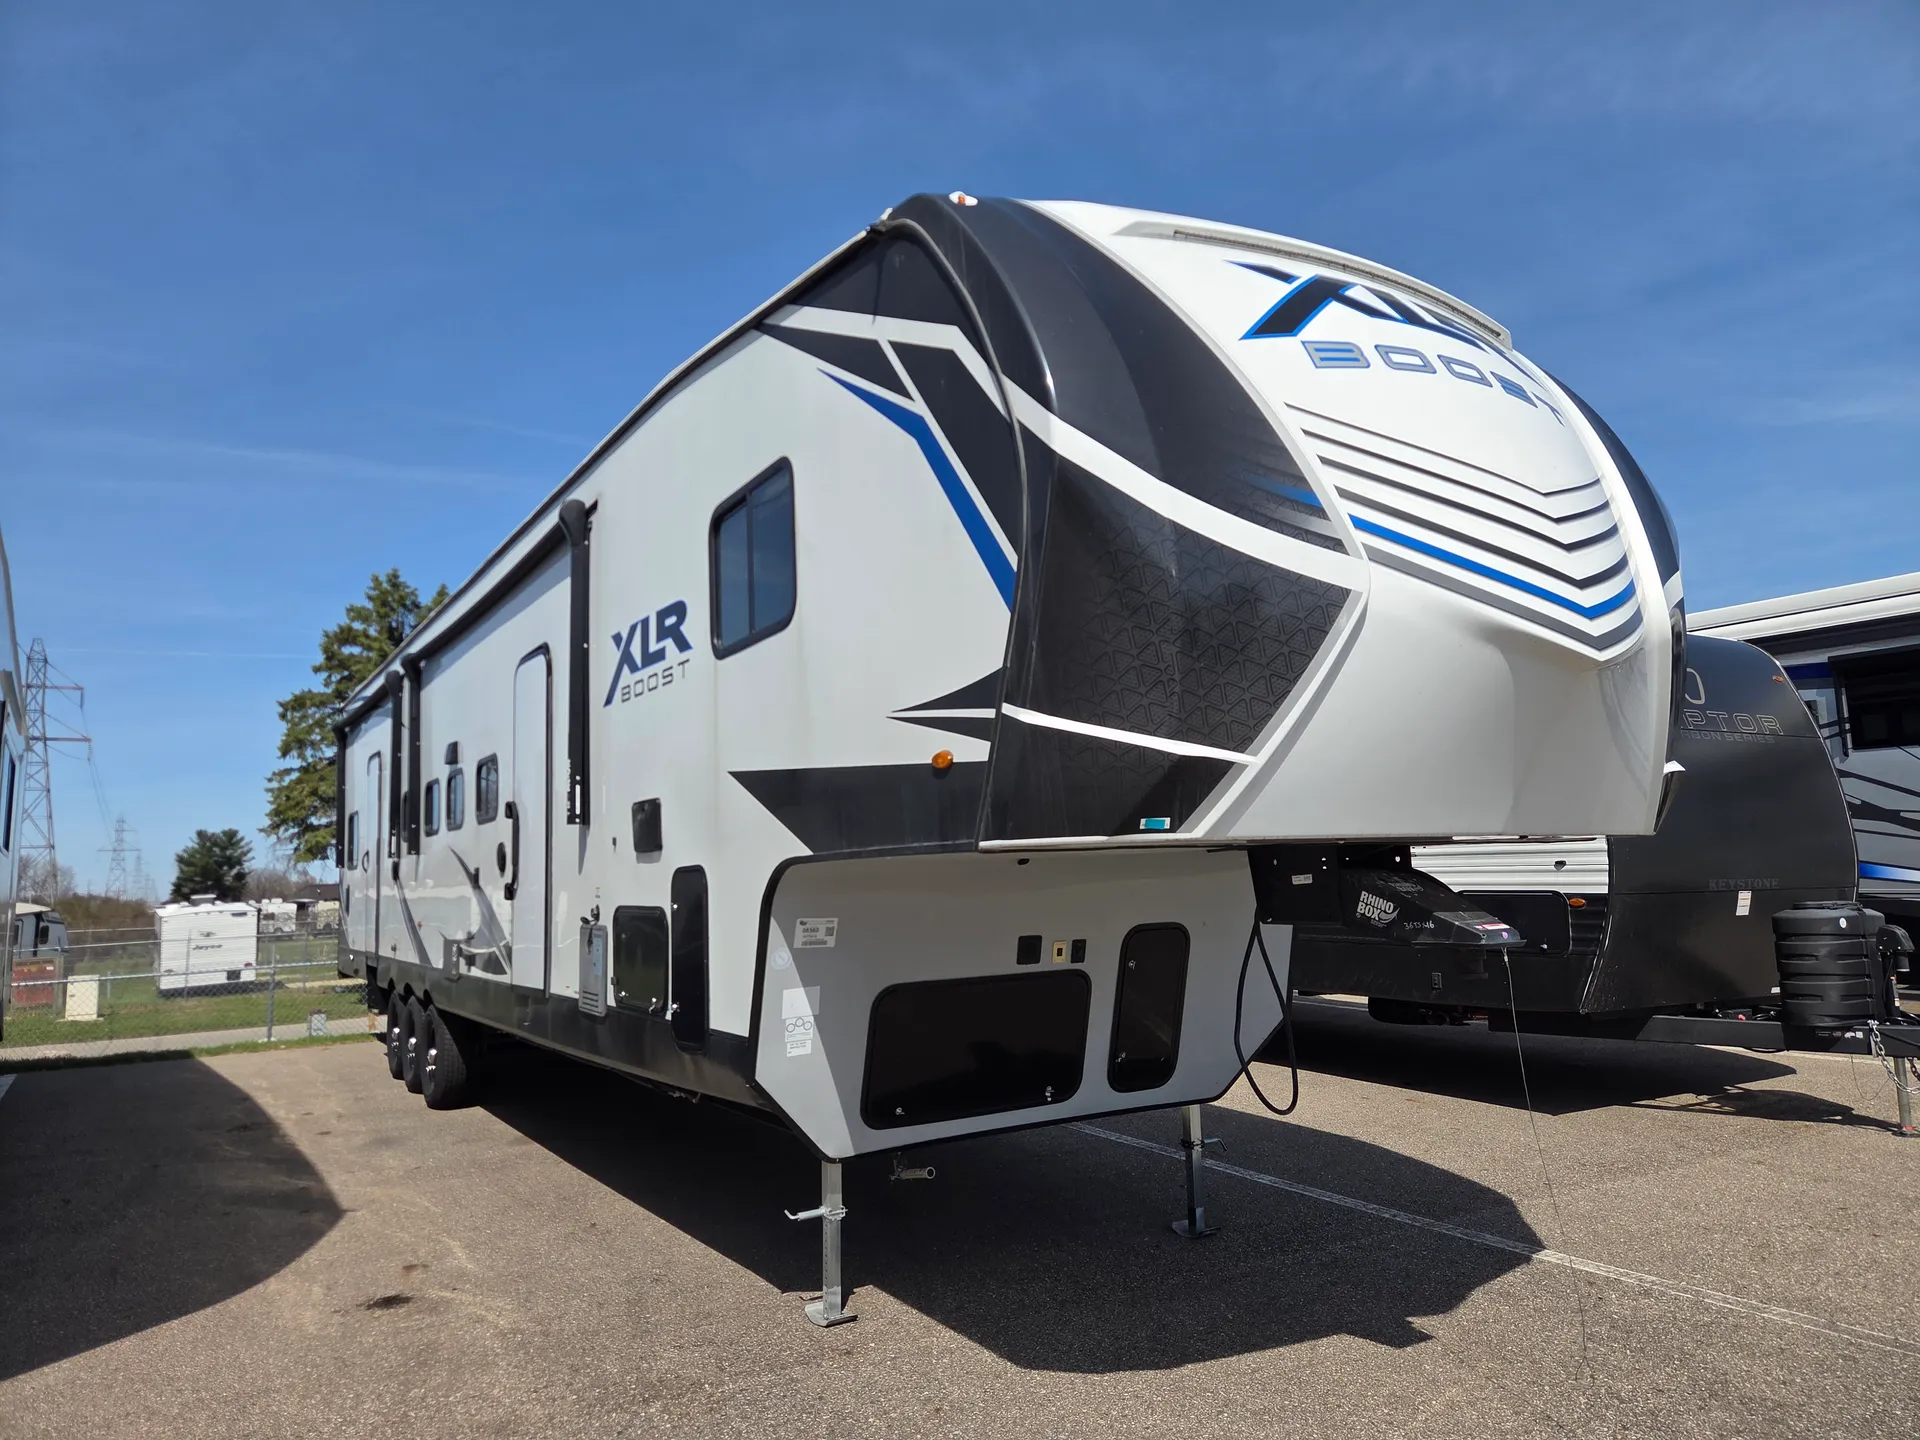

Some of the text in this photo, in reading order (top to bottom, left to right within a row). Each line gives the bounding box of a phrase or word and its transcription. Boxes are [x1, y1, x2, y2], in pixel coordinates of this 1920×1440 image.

[1300, 340, 1566, 427] BOOST
[603, 599, 694, 708] XLR
[621, 658, 690, 703] BOOST
[1681, 708, 1784, 735] PTOR
[1724, 732, 1775, 744] SERIES
[1708, 878, 1780, 891] KEYSTONE
[1356, 901, 1382, 921] BOX
[1360, 890, 1395, 914] RHINO
